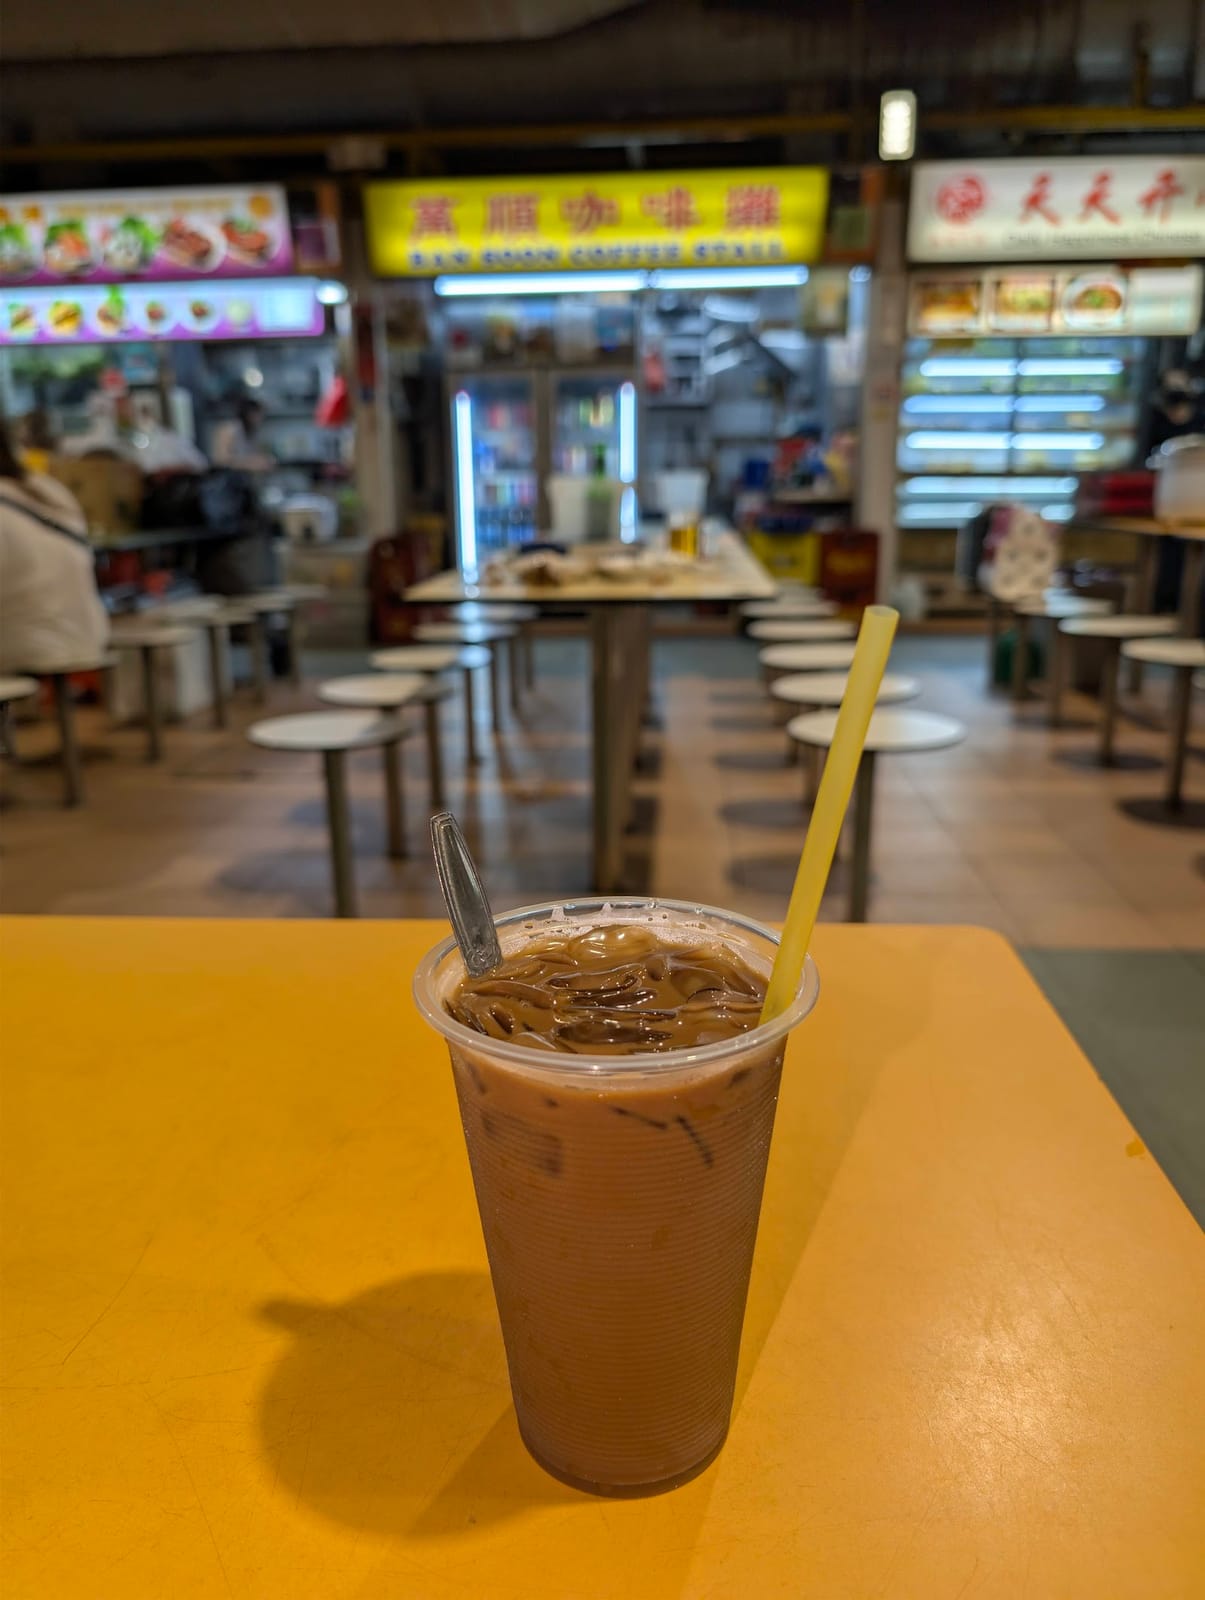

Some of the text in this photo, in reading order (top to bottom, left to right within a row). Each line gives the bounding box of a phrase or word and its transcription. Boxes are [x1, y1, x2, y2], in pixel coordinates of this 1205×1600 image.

[1019, 168, 1205, 226] 天天开
[481, 248, 560, 267] SOON
[569, 244, 681, 266] COFFEE
[694, 241, 785, 261] STALL
